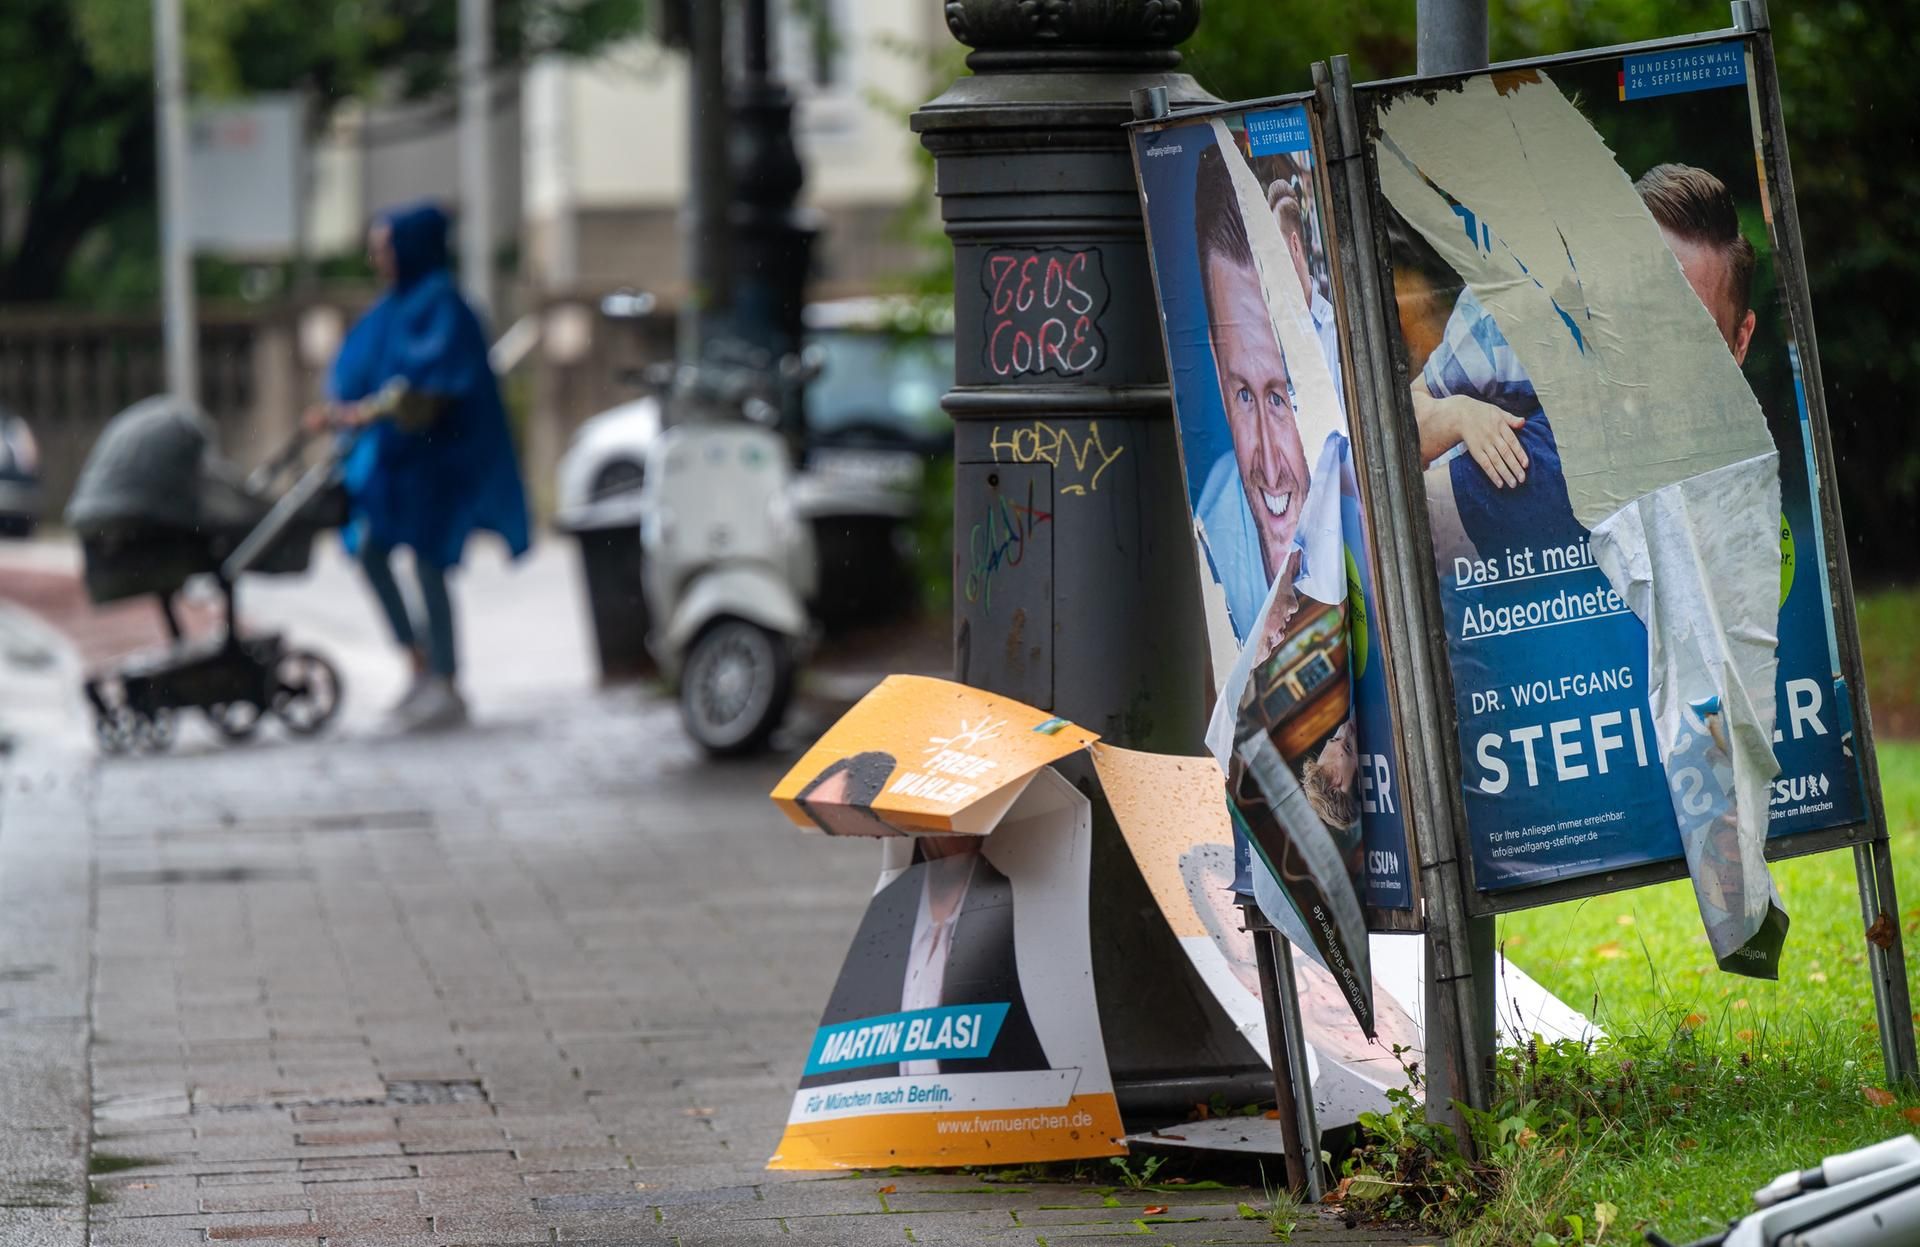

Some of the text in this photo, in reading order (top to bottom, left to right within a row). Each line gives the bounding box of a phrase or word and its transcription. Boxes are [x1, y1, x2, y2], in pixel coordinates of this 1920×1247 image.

[1629, 51, 1738, 75] BUNDESTAGSWAHL
[1631, 65, 1740, 89] 26. SEPTEMBER 2021
[1250, 116, 1302, 132] BUNDESTAGSWAHL
[1262, 132, 1293, 144] SEPTEMBER
[990, 315, 1098, 375] CORE
[989, 420, 1124, 491] HORNY
[1454, 556, 1500, 586] Das
[1505, 547, 1536, 577] ist
[1462, 586, 1630, 636] Abgeordnete
[1471, 666, 1634, 715] DR. WOLFGANG
[922, 750, 997, 778] FREIE
[1769, 809, 1787, 821] äher
[1800, 801, 1833, 815] Menschen
[1490, 810, 1627, 843] Für Ihre Anliegen immer erreichbar:
[1492, 830, 1599, 859] info@wolfgang-stefinger.de
[1368, 850, 1389, 875] CSU
[1312, 904, 1368, 1019] wolfgang-stefinger.de
[818, 1014, 982, 1065] MARTIN BLASI
[804, 1085, 953, 1114] Für München nach Berlin.
[937, 1111, 1093, 1135] www.fwmuenchen.de
